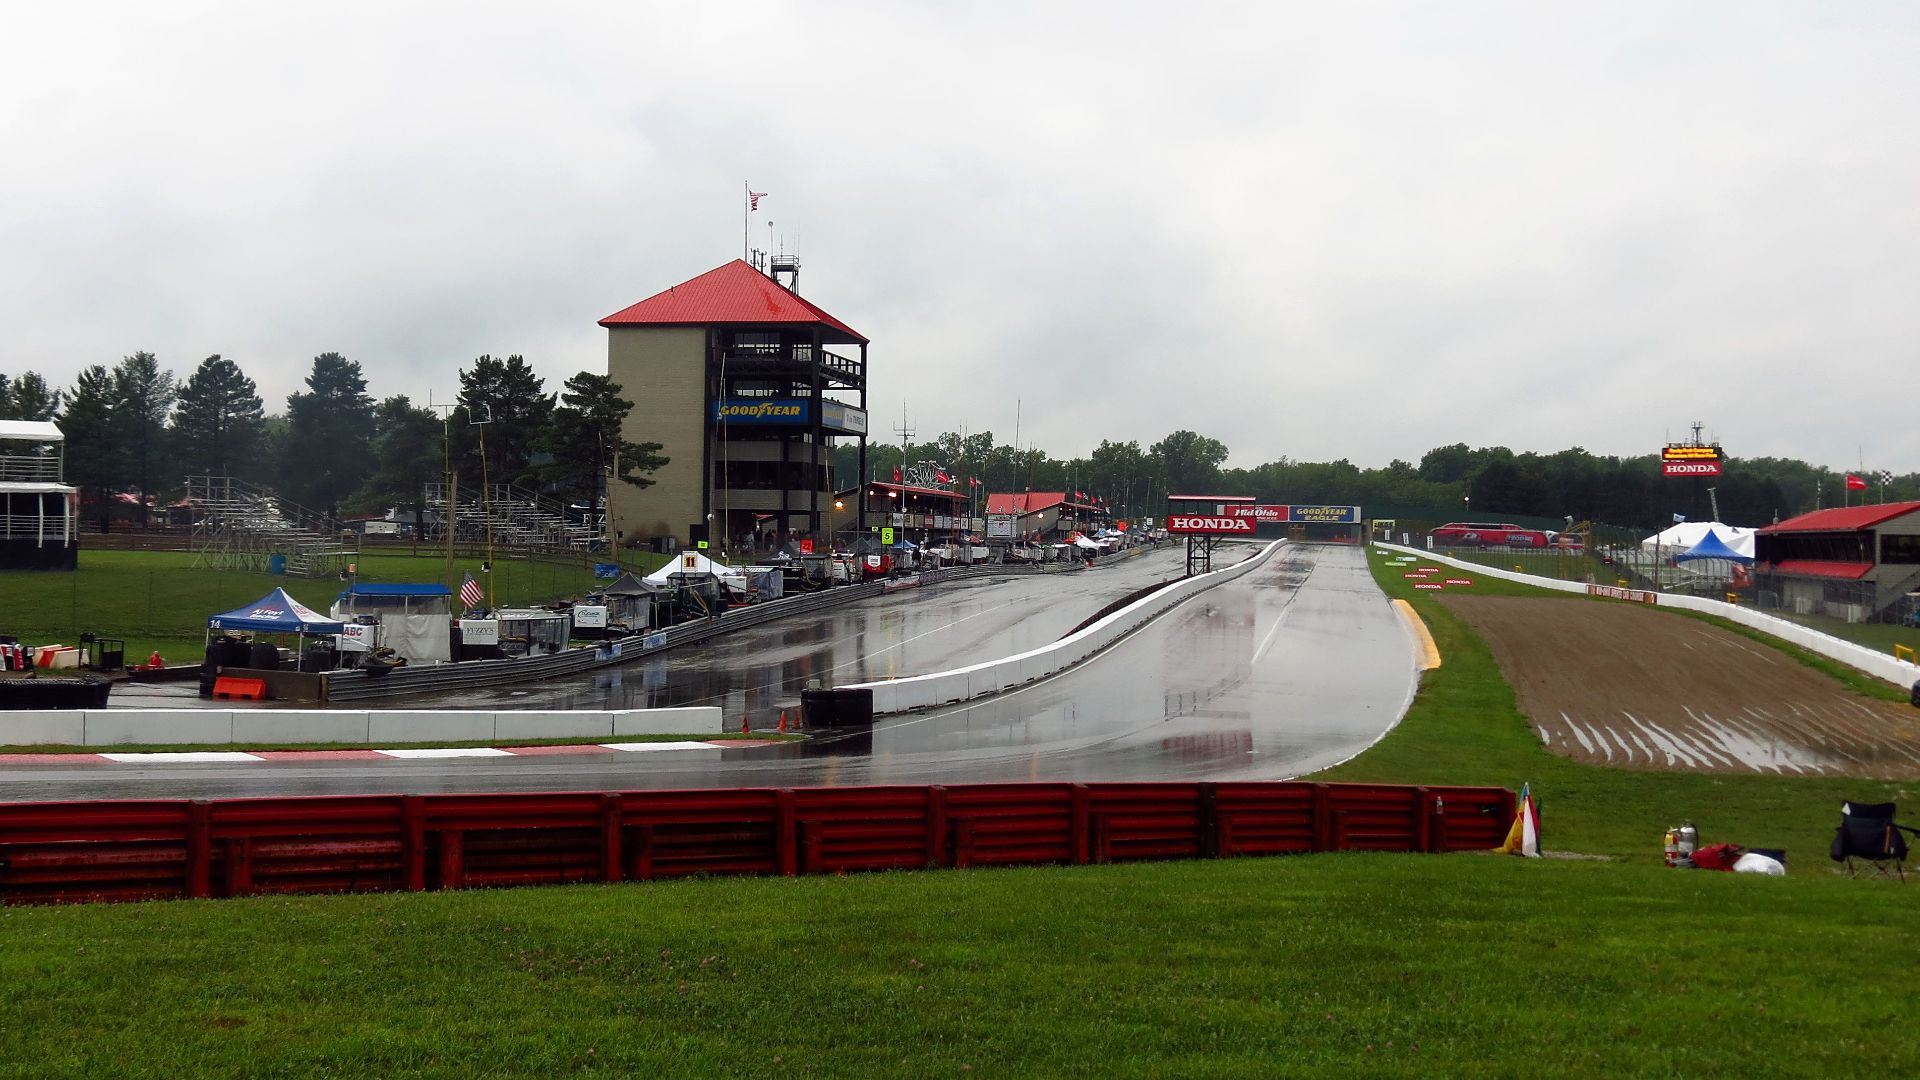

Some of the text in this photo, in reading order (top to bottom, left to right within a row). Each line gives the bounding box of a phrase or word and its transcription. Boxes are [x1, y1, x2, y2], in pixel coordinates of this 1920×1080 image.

[720, 402, 801, 418] GOODYEAR
[1666, 465, 1717, 473] HONDA
[1296, 507, 1347, 516] GOODYEAR
[1173, 518, 1250, 530] HONDA
[884, 532, 890, 540] 5
[686, 556, 695, 567] 11
[210, 620, 220, 628] 14
[344, 627, 363, 636] ABC
